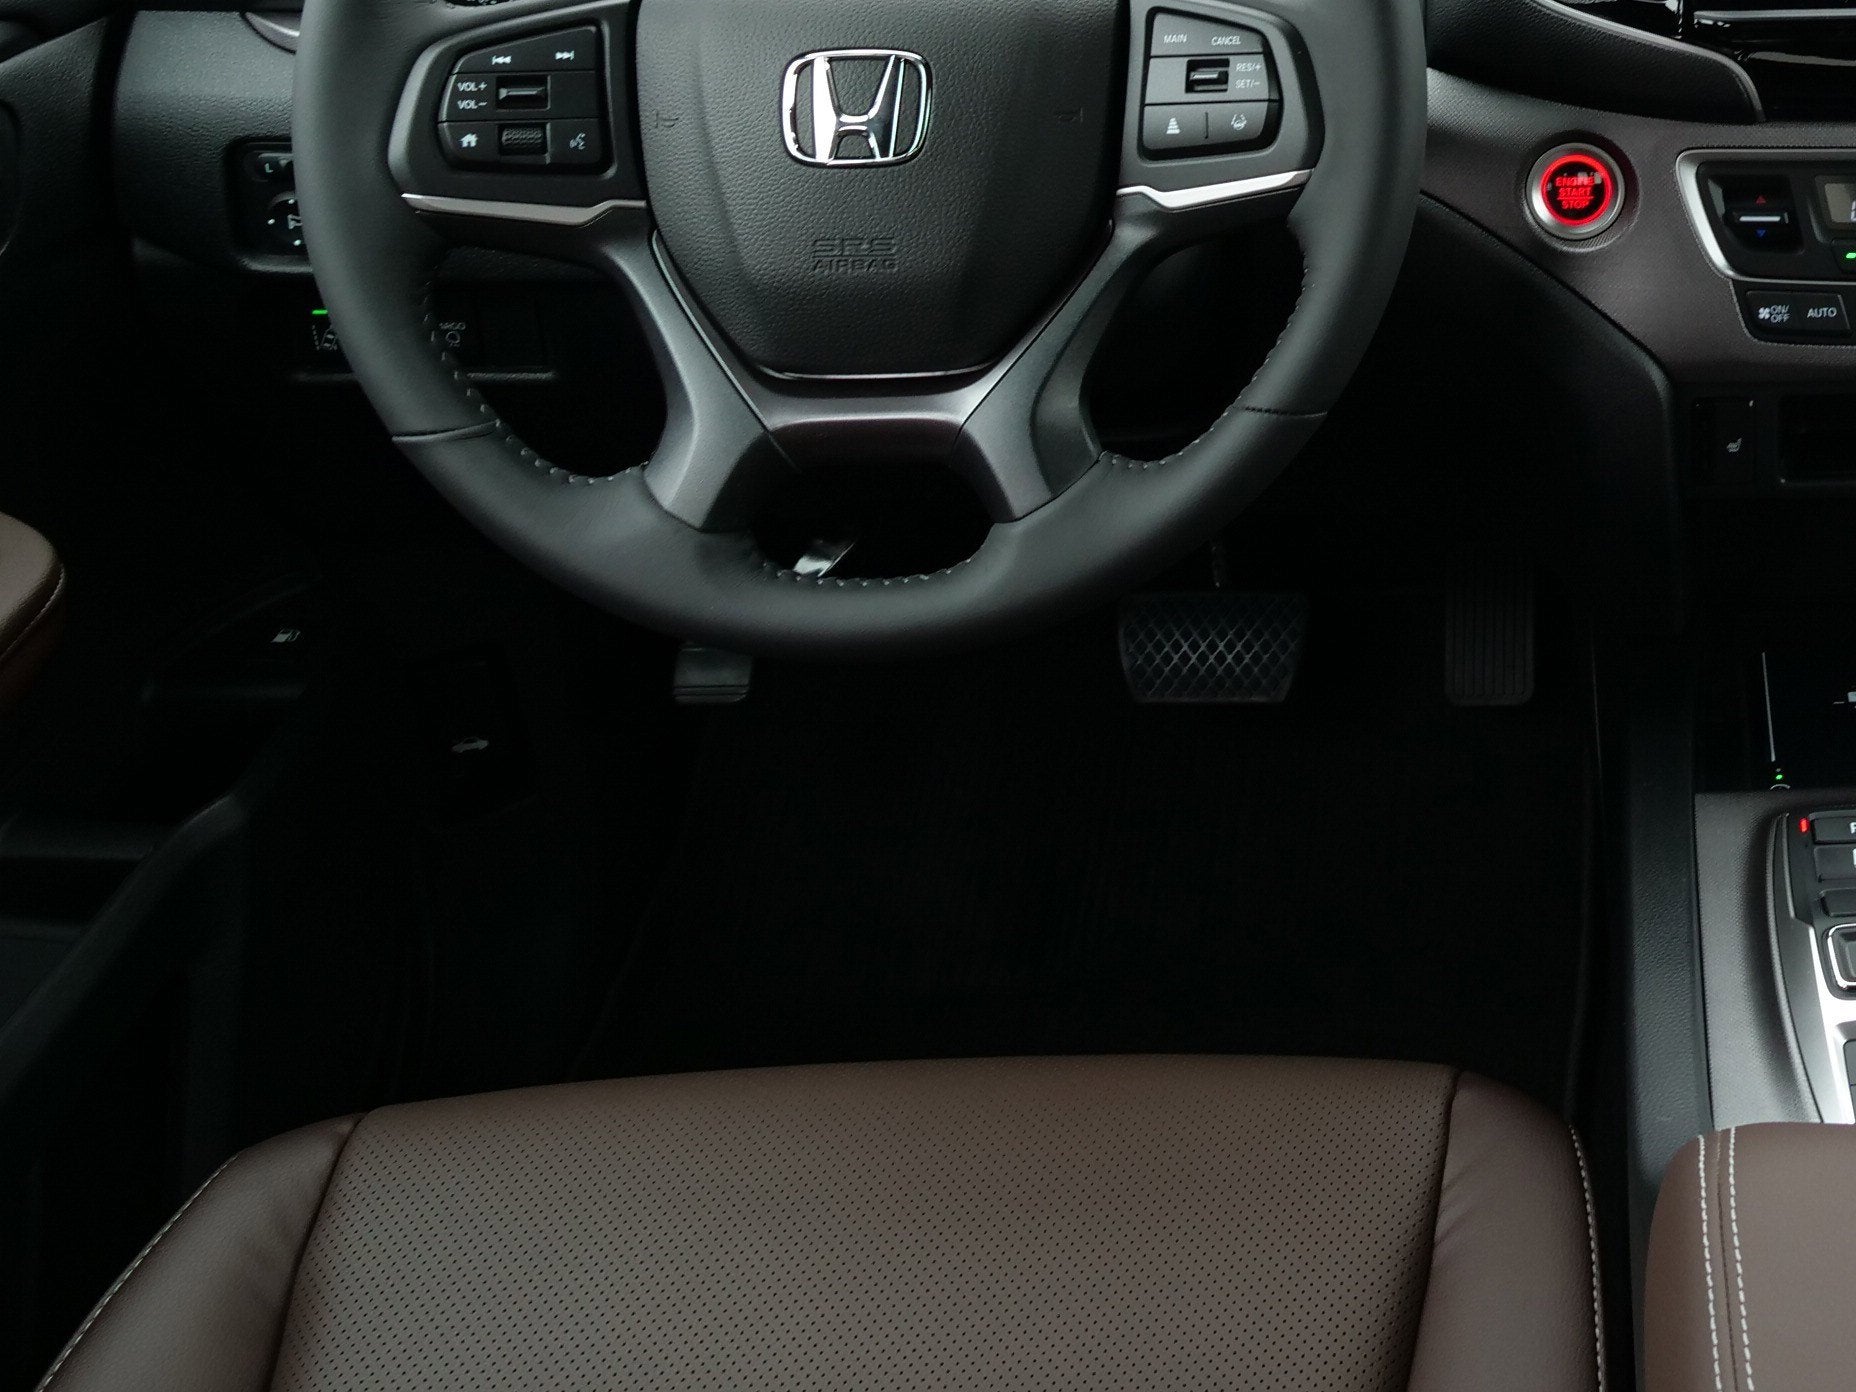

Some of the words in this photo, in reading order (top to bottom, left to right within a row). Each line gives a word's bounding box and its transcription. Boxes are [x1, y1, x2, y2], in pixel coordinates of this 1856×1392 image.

[1163, 33, 1188, 45] MAIN
[1211, 35, 1242, 47] CANCEL
[1555, 176, 1595, 187] ENGINE
[1558, 187, 1592, 197] START
[1561, 199, 1591, 210] STOP
[1770, 313, 1790, 323] OFF
[1806, 306, 1838, 319] AUTO
